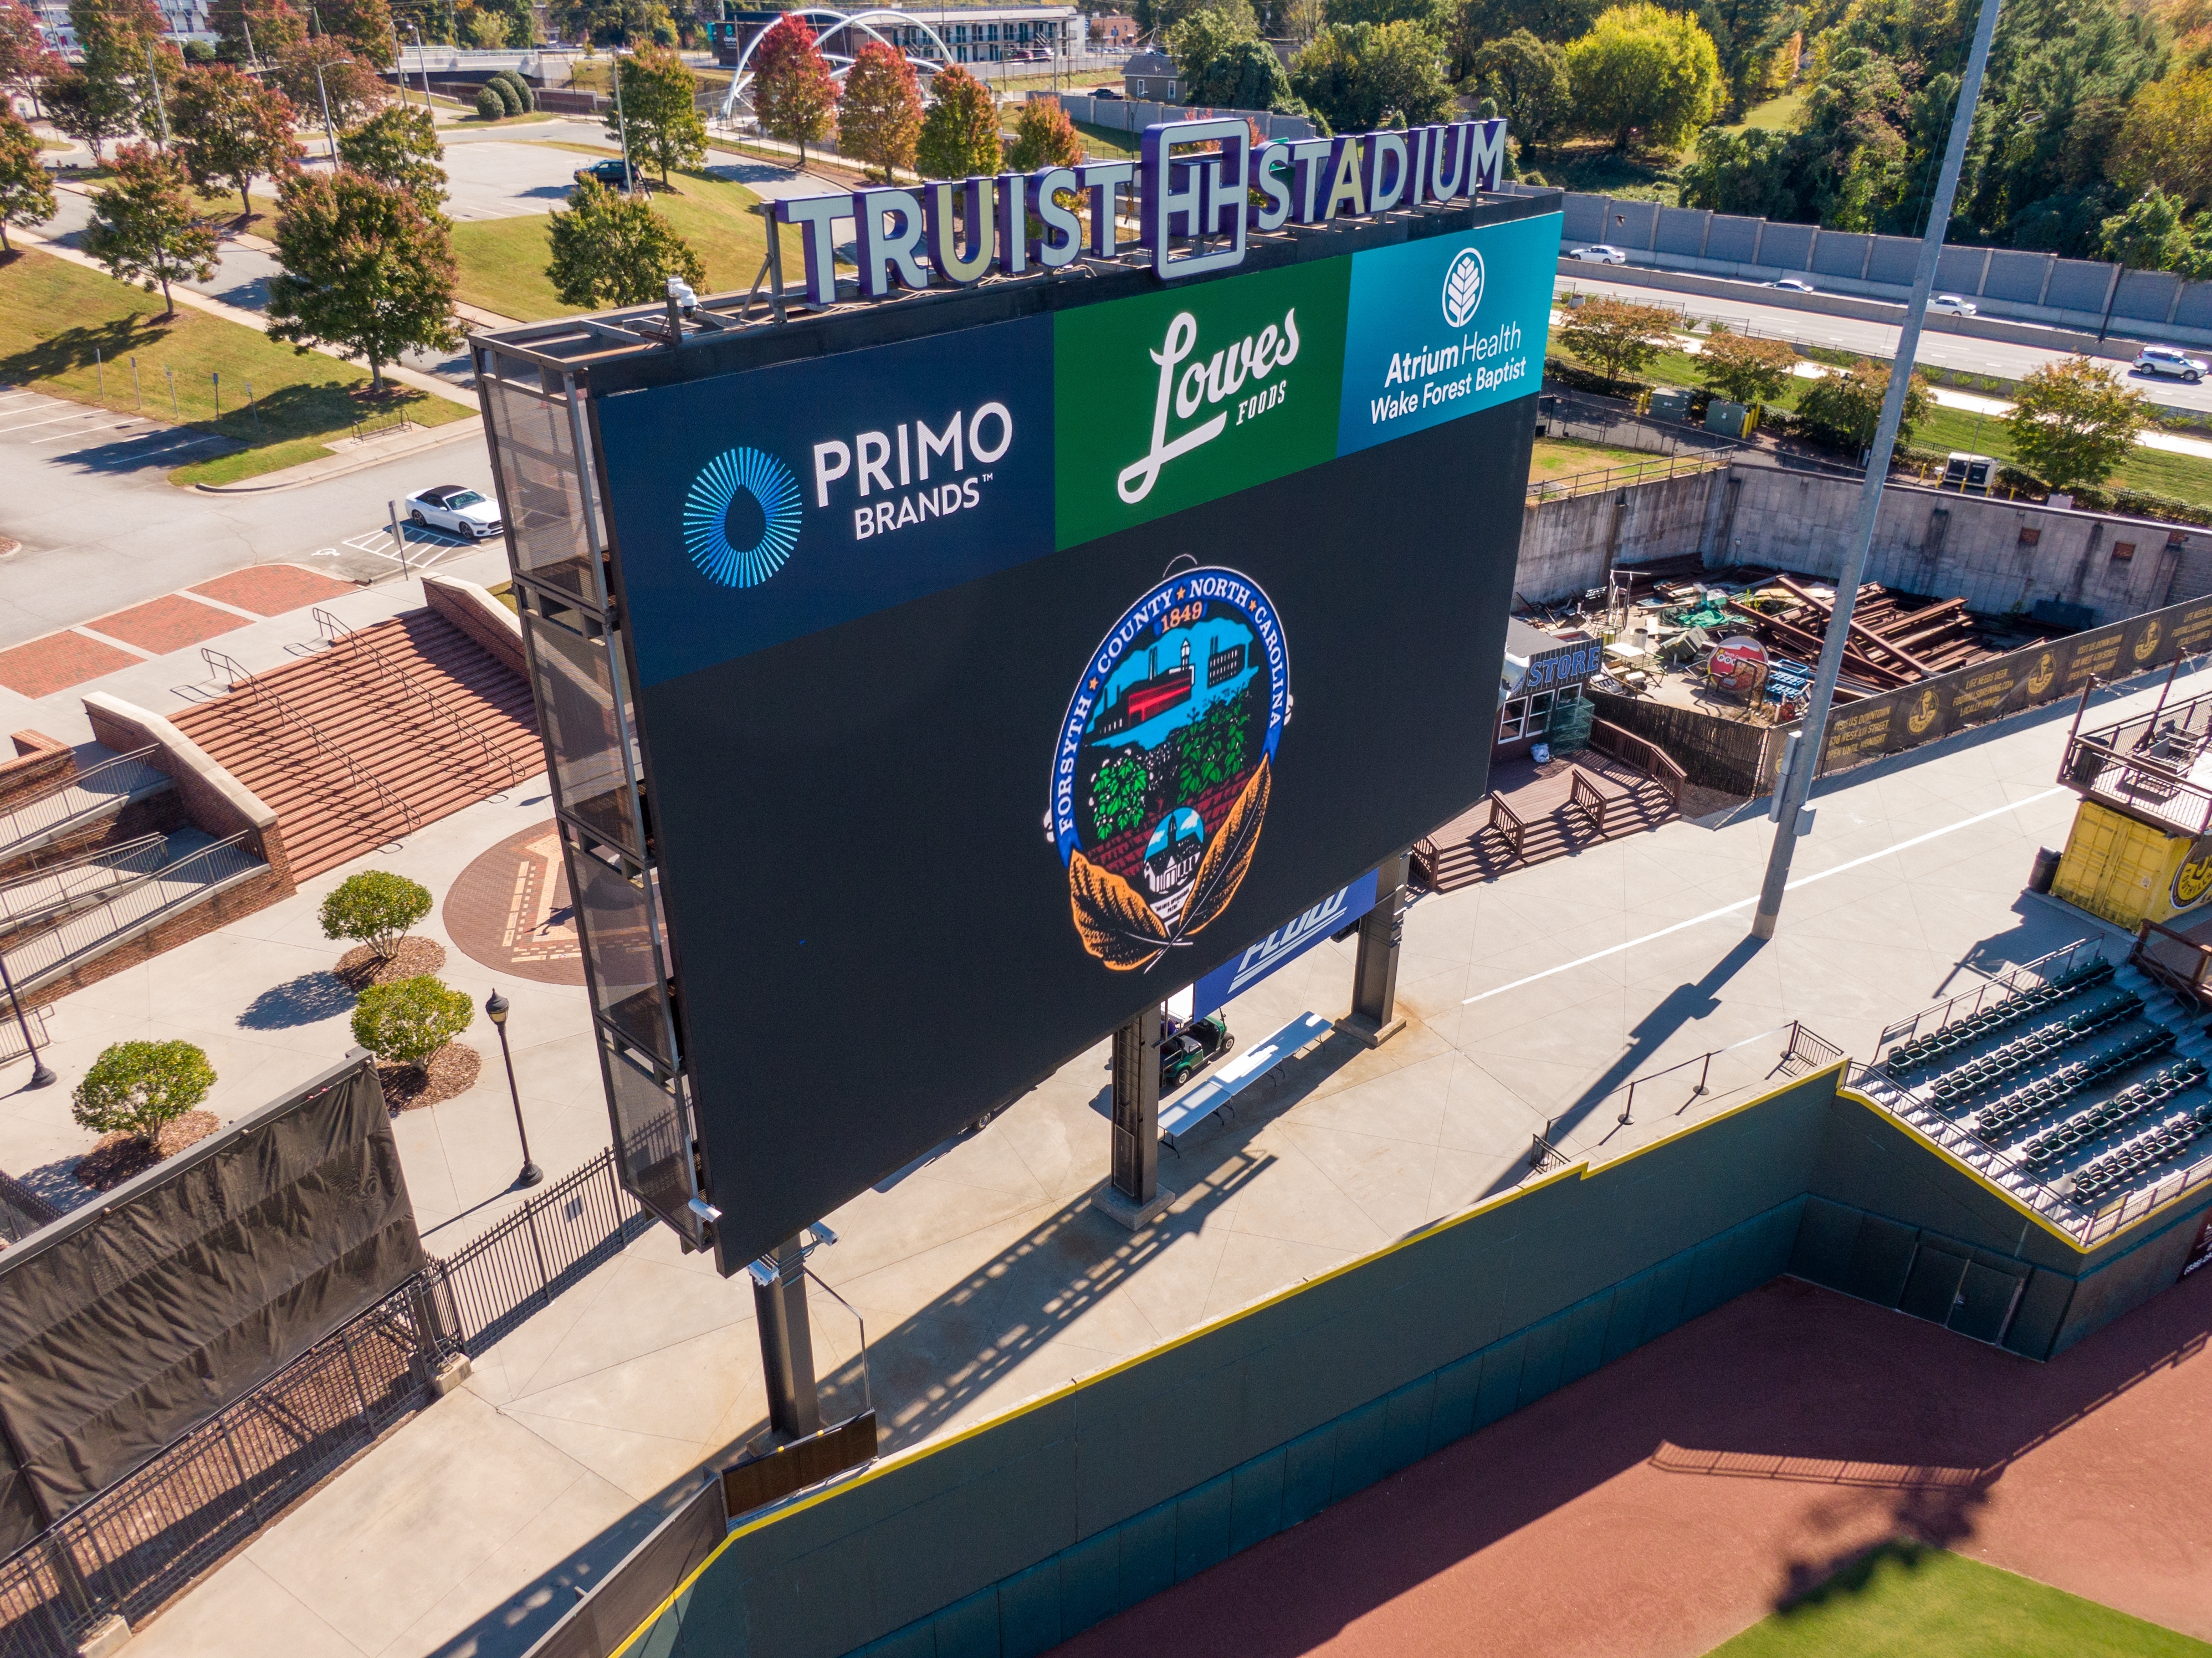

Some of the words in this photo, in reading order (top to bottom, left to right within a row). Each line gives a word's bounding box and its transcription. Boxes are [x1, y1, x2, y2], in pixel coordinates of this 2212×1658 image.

[776, 161, 1133, 305] TRUIST
[1251, 118, 1507, 231] STADIUM
[1384, 345, 1459, 388] Atrium
[1461, 320, 1522, 365] Health
[1117, 308, 1299, 504] Lowes
[1236, 380, 1287, 426] FOODS
[1370, 390, 1419, 424] Wake
[1422, 372, 1472, 409] Forest
[1475, 356, 1527, 392] Baptist
[813, 402, 1013, 508] PRIMO
[854, 477, 980, 541] BRANDS
[1160, 601, 1204, 634] 1849
[1527, 646, 1601, 687] STORE
[1057, 694, 1092, 836] FORSYTH
[1097, 587, 1174, 674] COUNTY
[1189, 576, 1252, 608] NORTH
[1253, 605, 1284, 729] CAROLINA
